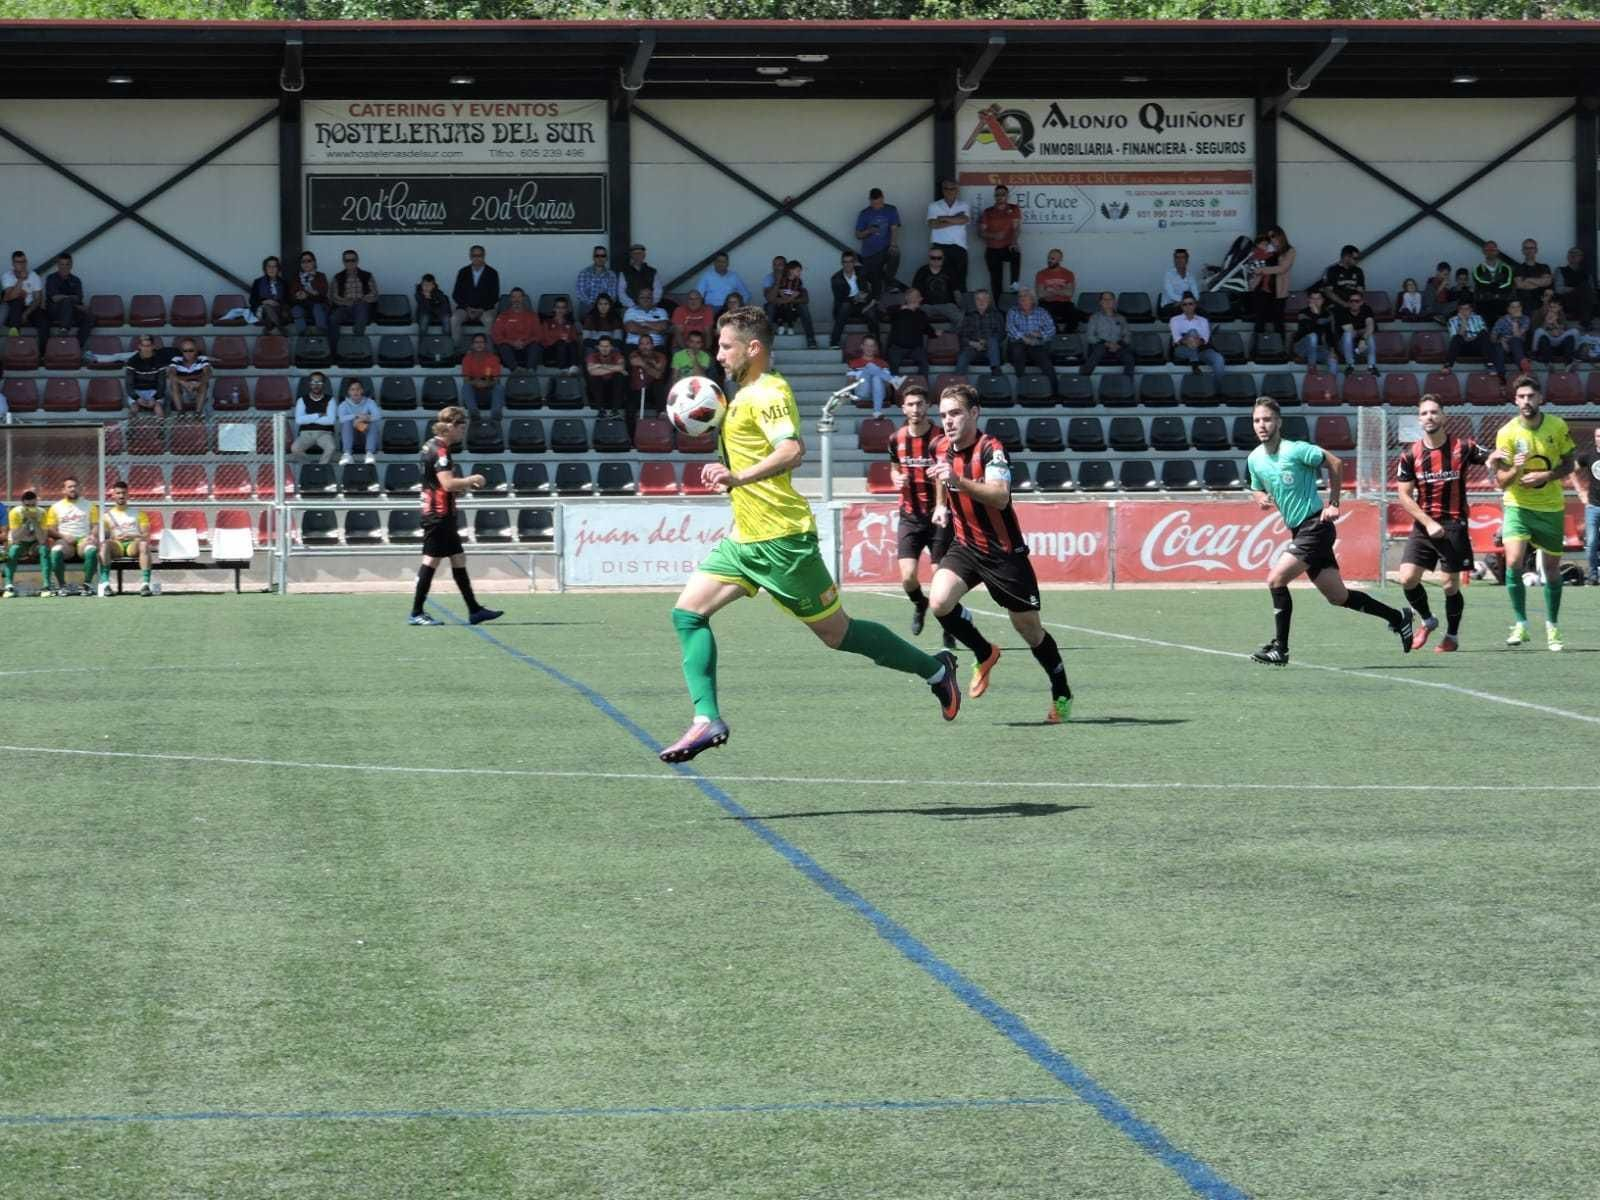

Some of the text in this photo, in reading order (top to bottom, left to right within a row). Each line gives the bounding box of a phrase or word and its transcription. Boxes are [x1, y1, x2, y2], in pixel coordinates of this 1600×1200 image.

[349, 103, 559, 117] CATERING Y EVENTOS
[314, 122, 596, 148] HOSTELERIAS DEL SUR
[1039, 142, 1113, 155] INMOBILIARIA
[1122, 142, 1187, 155] FINANCIERA
[1195, 141, 1247, 155] SEGUROS
[1016, 191, 1079, 209] El Cruce
[1168, 199, 1205, 207] AVISOS
[574, 519, 640, 557] juan
[647, 514, 692, 544] del
[1140, 509, 1353, 572] Coca-C
[1022, 531, 1098, 562] mpo
[601, 560, 699, 574] DISTRIB
